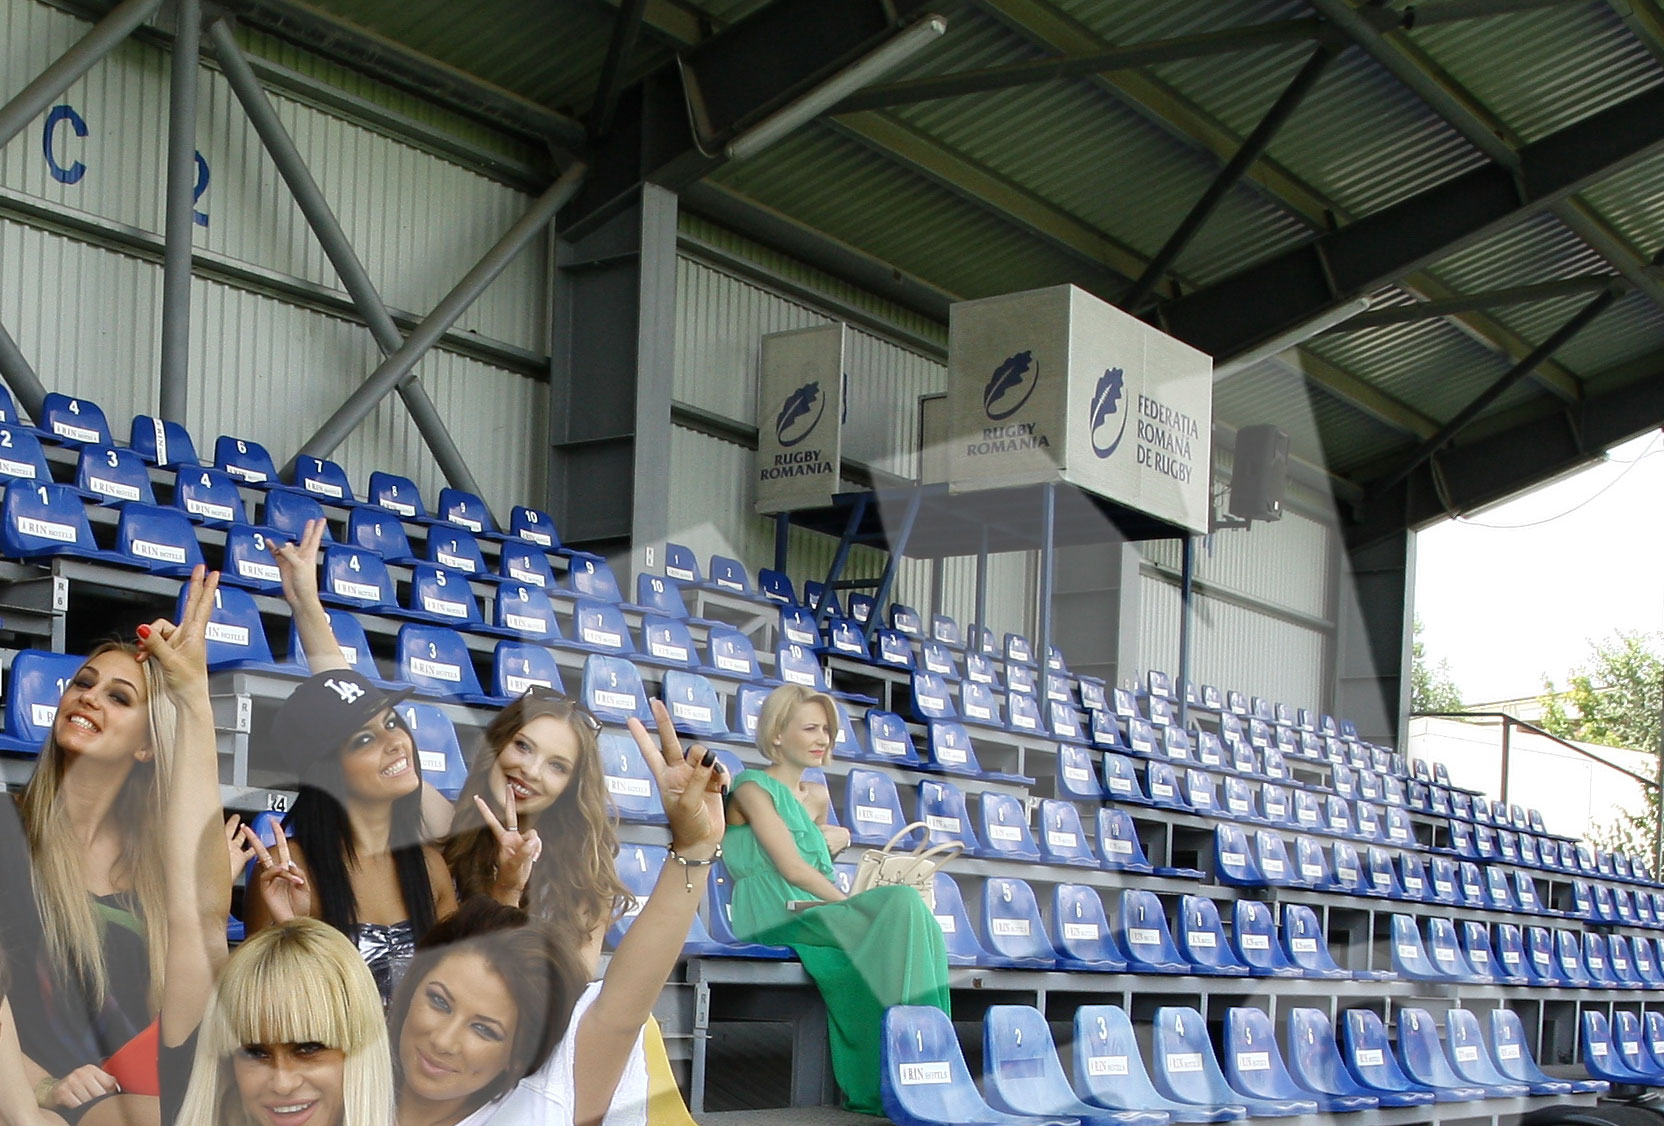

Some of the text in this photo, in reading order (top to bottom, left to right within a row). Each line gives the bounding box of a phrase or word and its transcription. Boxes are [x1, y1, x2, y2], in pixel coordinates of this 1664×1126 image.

[43, 105, 89, 184] C
[69, 401, 79, 415] 4
[0, 430, 13, 448] 2
[983, 423, 1036, 440] RUGBY
[237, 441, 247, 454] 6
[967, 435, 1050, 456] ROMANIA
[106, 450, 119, 467] 3
[774, 449, 821, 466] RUGBY
[1137, 444, 1192, 484] DE RUGBY
[314, 460, 323, 473] 7
[760, 461, 833, 480] ROMANIA
[99, 480, 116, 494] RIN
[200, 473, 211, 489] 4
[38, 486, 49, 505] 1
[525, 510, 538, 524] 10
[28, 520, 48, 535] RIN
[141, 543, 158, 557] RIN
[254, 534, 265, 550] 3
[349, 555, 360, 571] 4
[586, 561, 594, 574] 9
[436, 570, 447, 587] 5
[651, 578, 664, 593] 10
[518, 587, 528, 602] 6
[429, 643, 437, 659] 3
[523, 659, 530, 675] 4
[323, 678, 365, 704] LA
[688, 688, 694, 701] 6
[406, 708, 418, 730] 1
[621, 755, 628, 772] 3
[869, 787, 875, 801] 6
[934, 785, 942, 801] 7
[634, 849, 647, 871] 1
[838, 872, 850, 893] 3
[1002, 882, 1012, 901] 5
[1075, 902, 1082, 917] 6
[1248, 906, 1256, 921] 9
[1096, 1017, 1107, 1040] 3
[1175, 1015, 1184, 1037] 4
[1356, 1014, 1364, 1033] 7
[1410, 1014, 1419, 1031] 8
[915, 1030, 923, 1052] 1
[1015, 1028, 1022, 1047] 2
[1245, 1027, 1252, 1045] 5
[1307, 1028, 1314, 1044] 6
